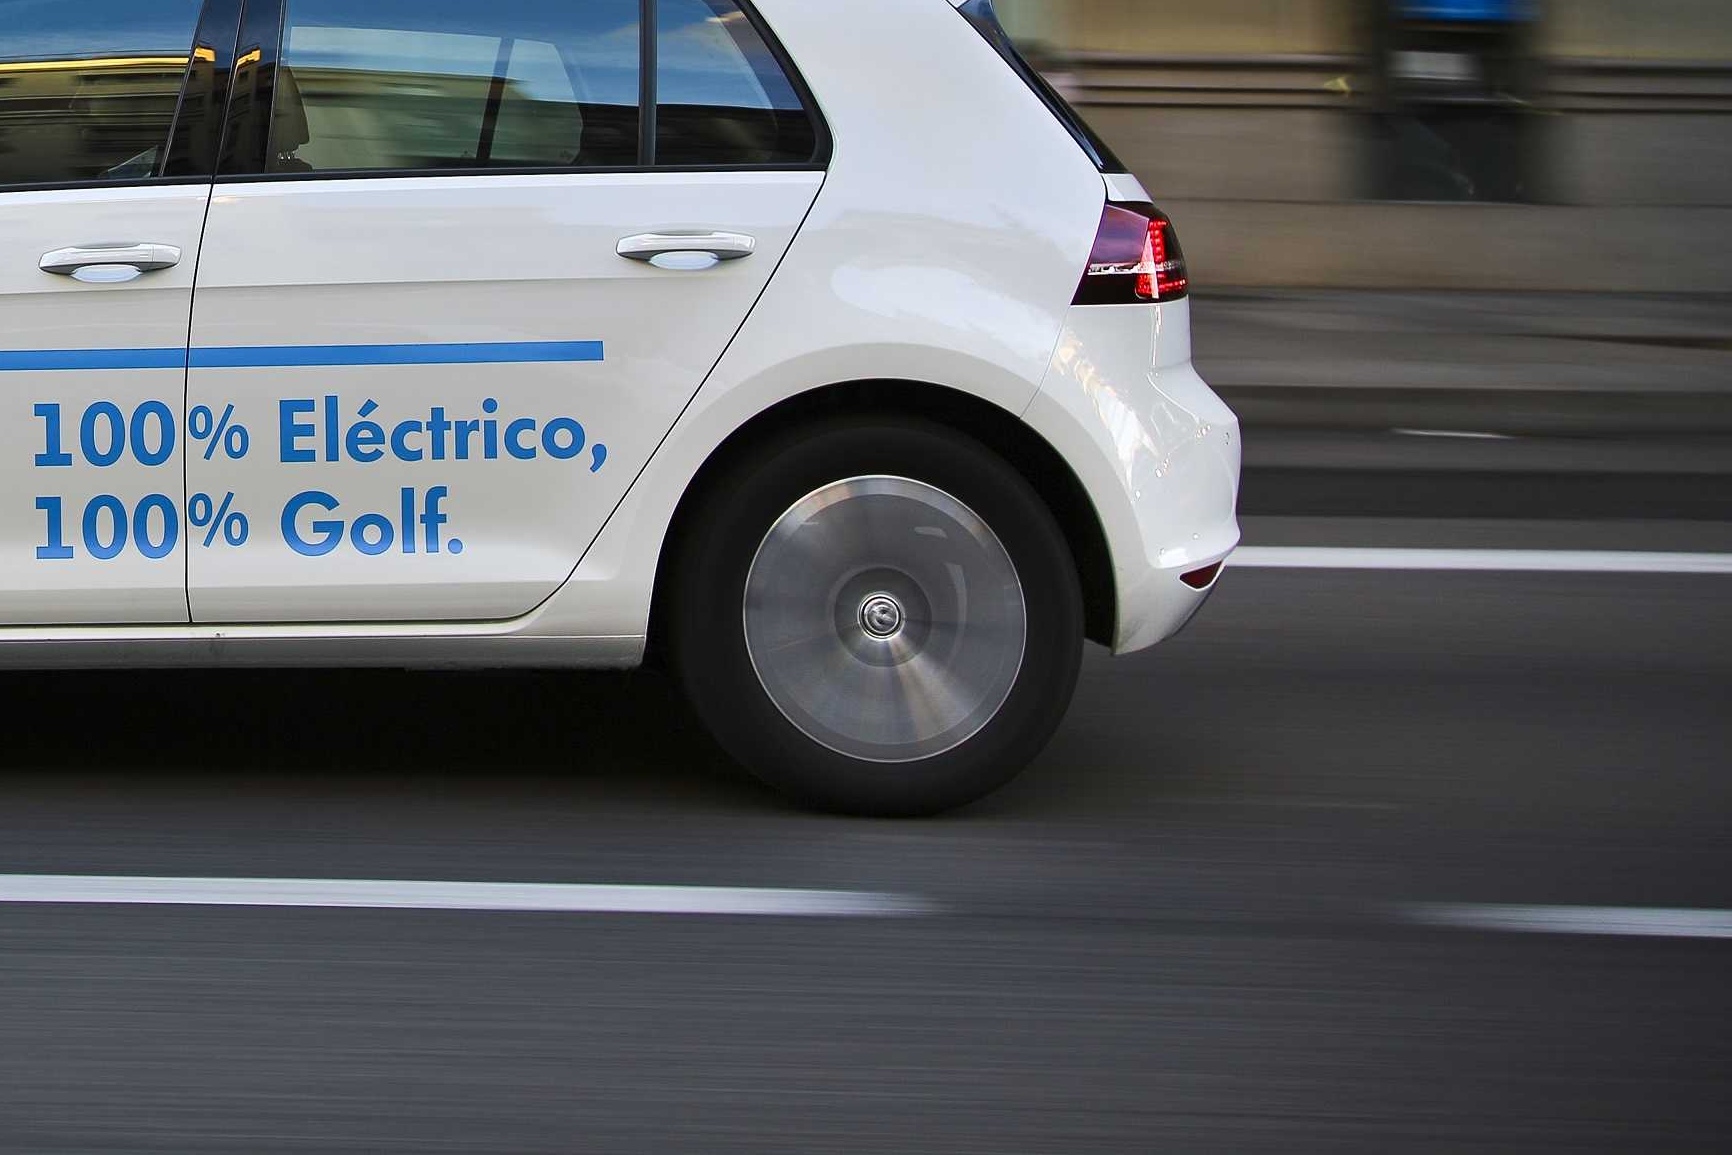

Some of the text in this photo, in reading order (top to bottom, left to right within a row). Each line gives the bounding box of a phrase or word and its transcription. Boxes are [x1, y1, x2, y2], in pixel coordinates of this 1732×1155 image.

[32, 395, 609, 473] 100% Eléctrico,
[34, 485, 465, 561] 100% Golf.
